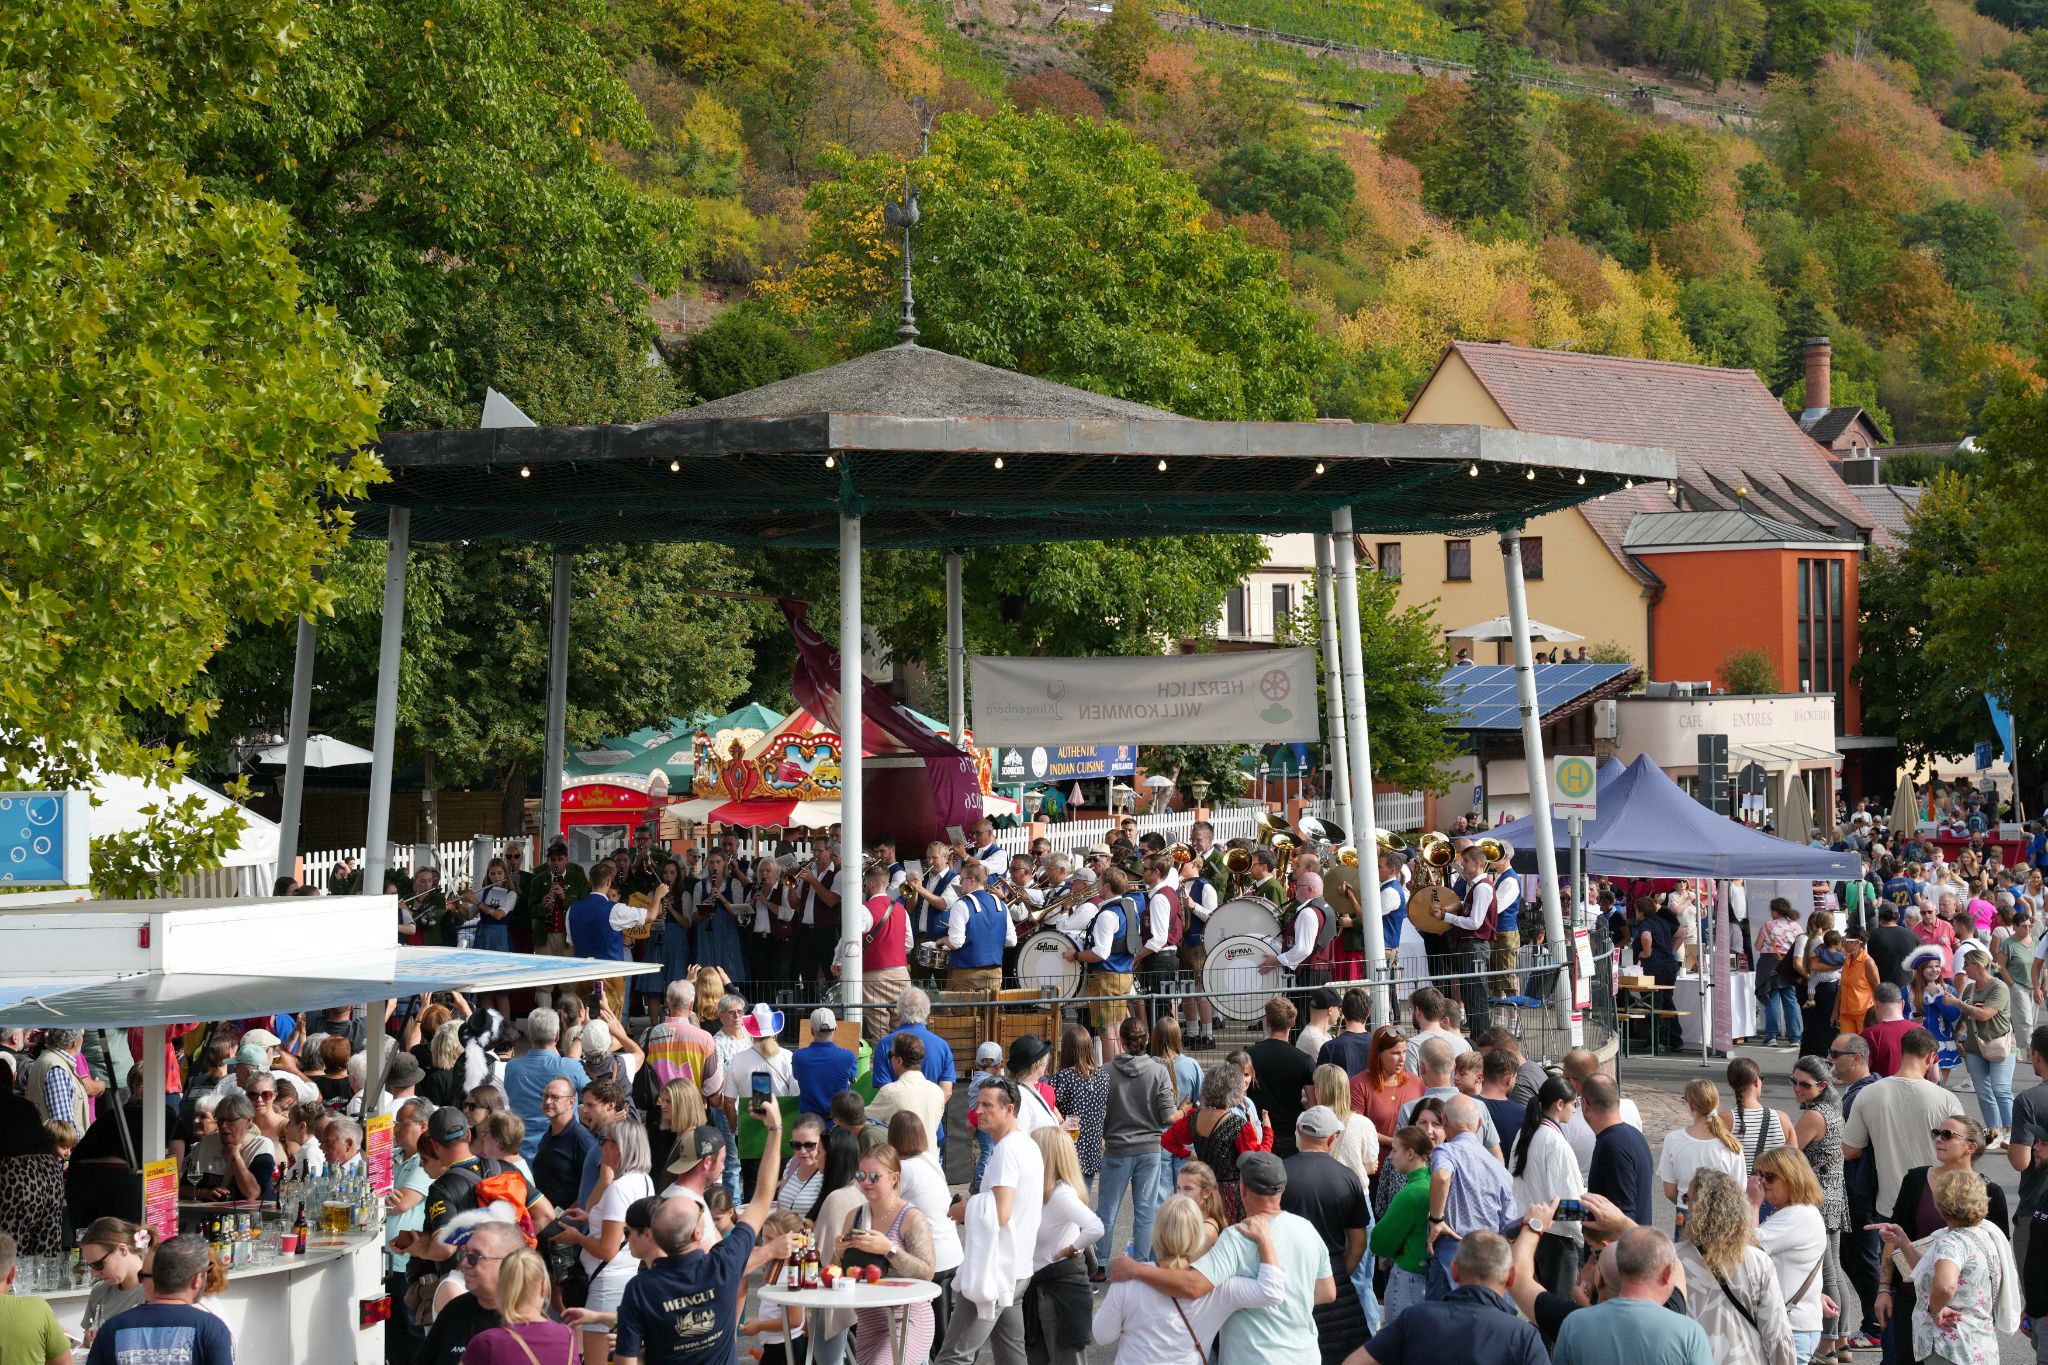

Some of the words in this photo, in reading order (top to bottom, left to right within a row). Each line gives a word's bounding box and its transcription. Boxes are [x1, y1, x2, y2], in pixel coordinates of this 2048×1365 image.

[1680, 712, 1704, 728] CAFÉ
[1733, 712, 1773, 728] ENDRES
[1794, 709, 1831, 722] BÄCKEREI
[1057, 745, 1098, 763] AUTHENTIC
[1050, 762, 1075, 776] INDIAN
[1076, 760, 1105, 774] CUISINE
[1567, 767, 1583, 788] H
[662, 1287, 717, 1312] WEINGUT
[117, 1348, 168, 1359] REFOCUS
[119, 1355, 142, 1364] THE
